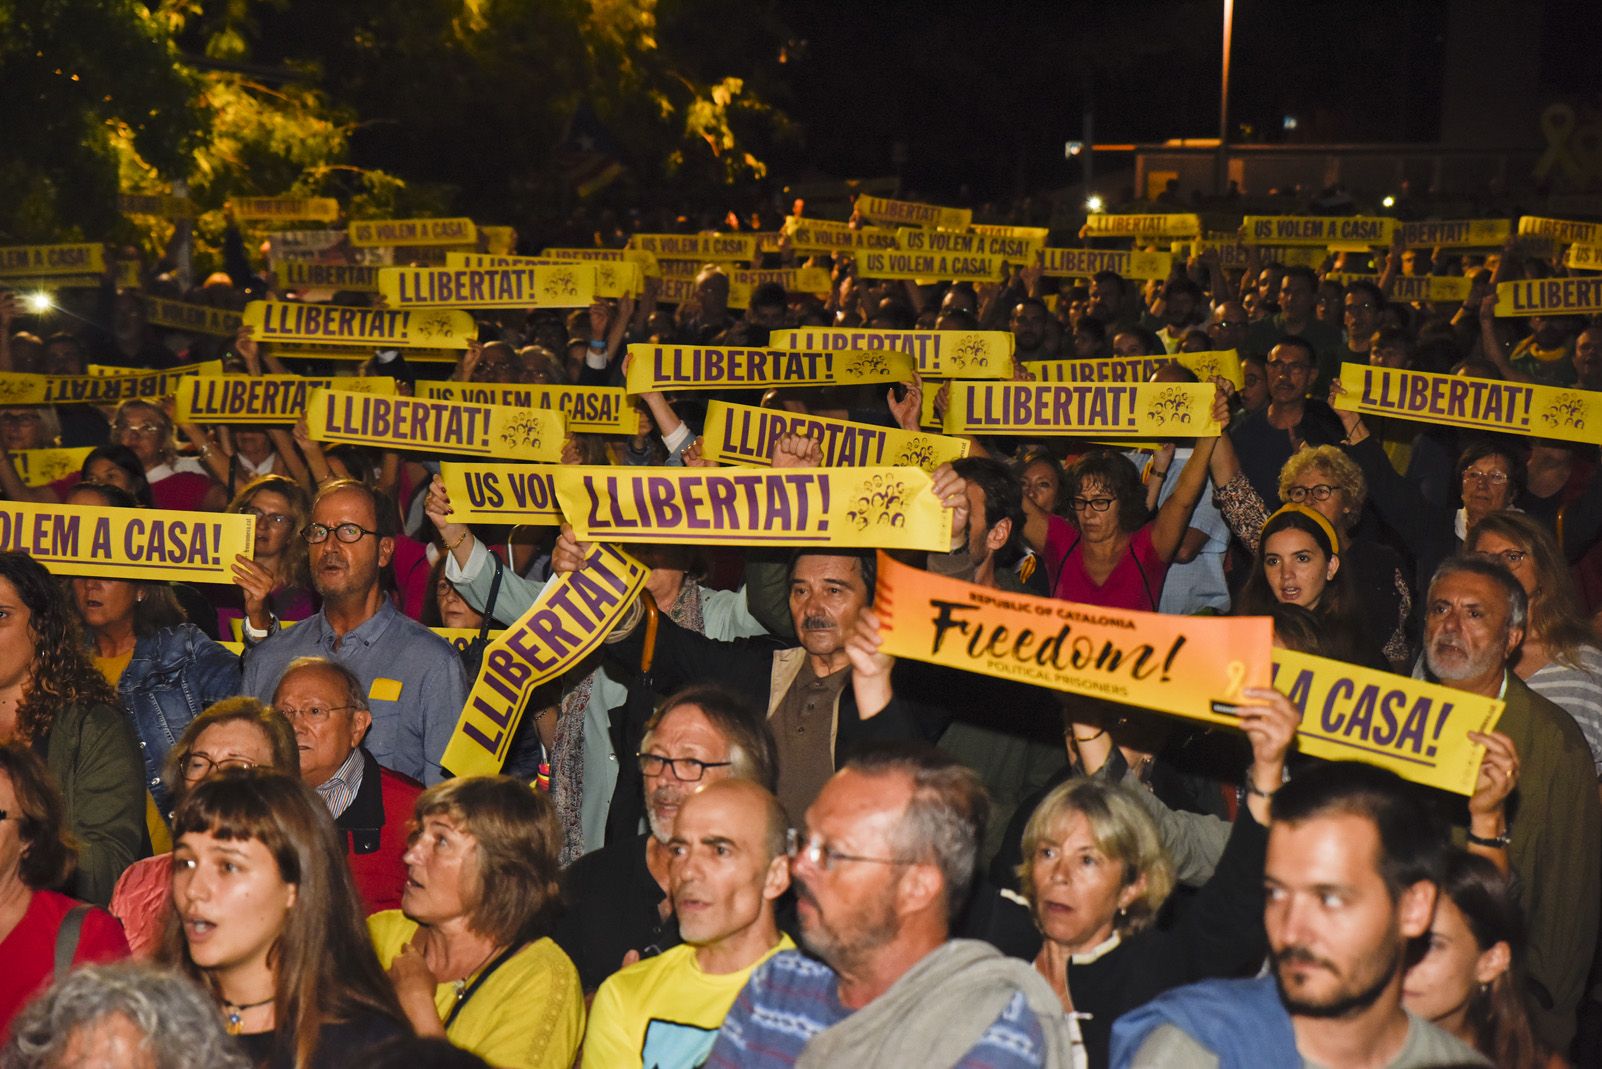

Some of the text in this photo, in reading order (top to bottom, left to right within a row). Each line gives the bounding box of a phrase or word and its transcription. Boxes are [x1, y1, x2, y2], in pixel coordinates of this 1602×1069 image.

[869, 198, 941, 223] LLIBERTAT!
[1097, 216, 1167, 233] LLIBERTAT!
[642, 238, 656, 252] US
[660, 238, 698, 252] VOLEM
[702, 238, 709, 252] A
[713, 239, 748, 252] CASA!
[796, 229, 810, 243] US
[814, 230, 851, 245] VOLEM
[856, 233, 863, 246] A
[867, 234, 897, 249] CASA
[908, 232, 1030, 256] US VOLEM A CASA!
[1254, 220, 1271, 237] US
[1277, 220, 1323, 237] VOLEM
[1328, 220, 1337, 237] A
[1341, 220, 1384, 238] CASA!
[1404, 222, 1470, 243] IBERTAT!
[288, 263, 379, 285] LLIBERTAT
[867, 255, 992, 275] US VOLEM A CASA!
[1041, 250, 1132, 274] LLIBERTAT!
[400, 269, 535, 302] LLIBERTAT!
[1513, 280, 1602, 309] LLIBERT
[264, 304, 410, 338] LLIBERTAT!
[653, 347, 833, 382] LLIBERTAT!
[44, 369, 198, 401] IBERTAT!
[191, 380, 331, 414] LLIBERTA
[1361, 369, 1534, 426] LLIBERTAT!
[325, 394, 491, 446] LLIBERTAT!
[560, 392, 621, 421] CASA!
[966, 386, 1138, 426] LLIBERTAT!
[464, 472, 560, 509] US VOL
[587, 474, 831, 531] LLIBERTAT!
[0, 511, 80, 557] OLEM
[91, 517, 112, 560] A
[124, 518, 222, 565] CASA!
[969, 592, 1136, 630] REPUBLIC OF CATALONIA
[462, 542, 639, 755] LLIBERTAT!
[930, 600, 1186, 683] Freedom!
[987, 660, 1128, 696] POLITICAL PRISONERS
[1321, 678, 1454, 757] CASA!
